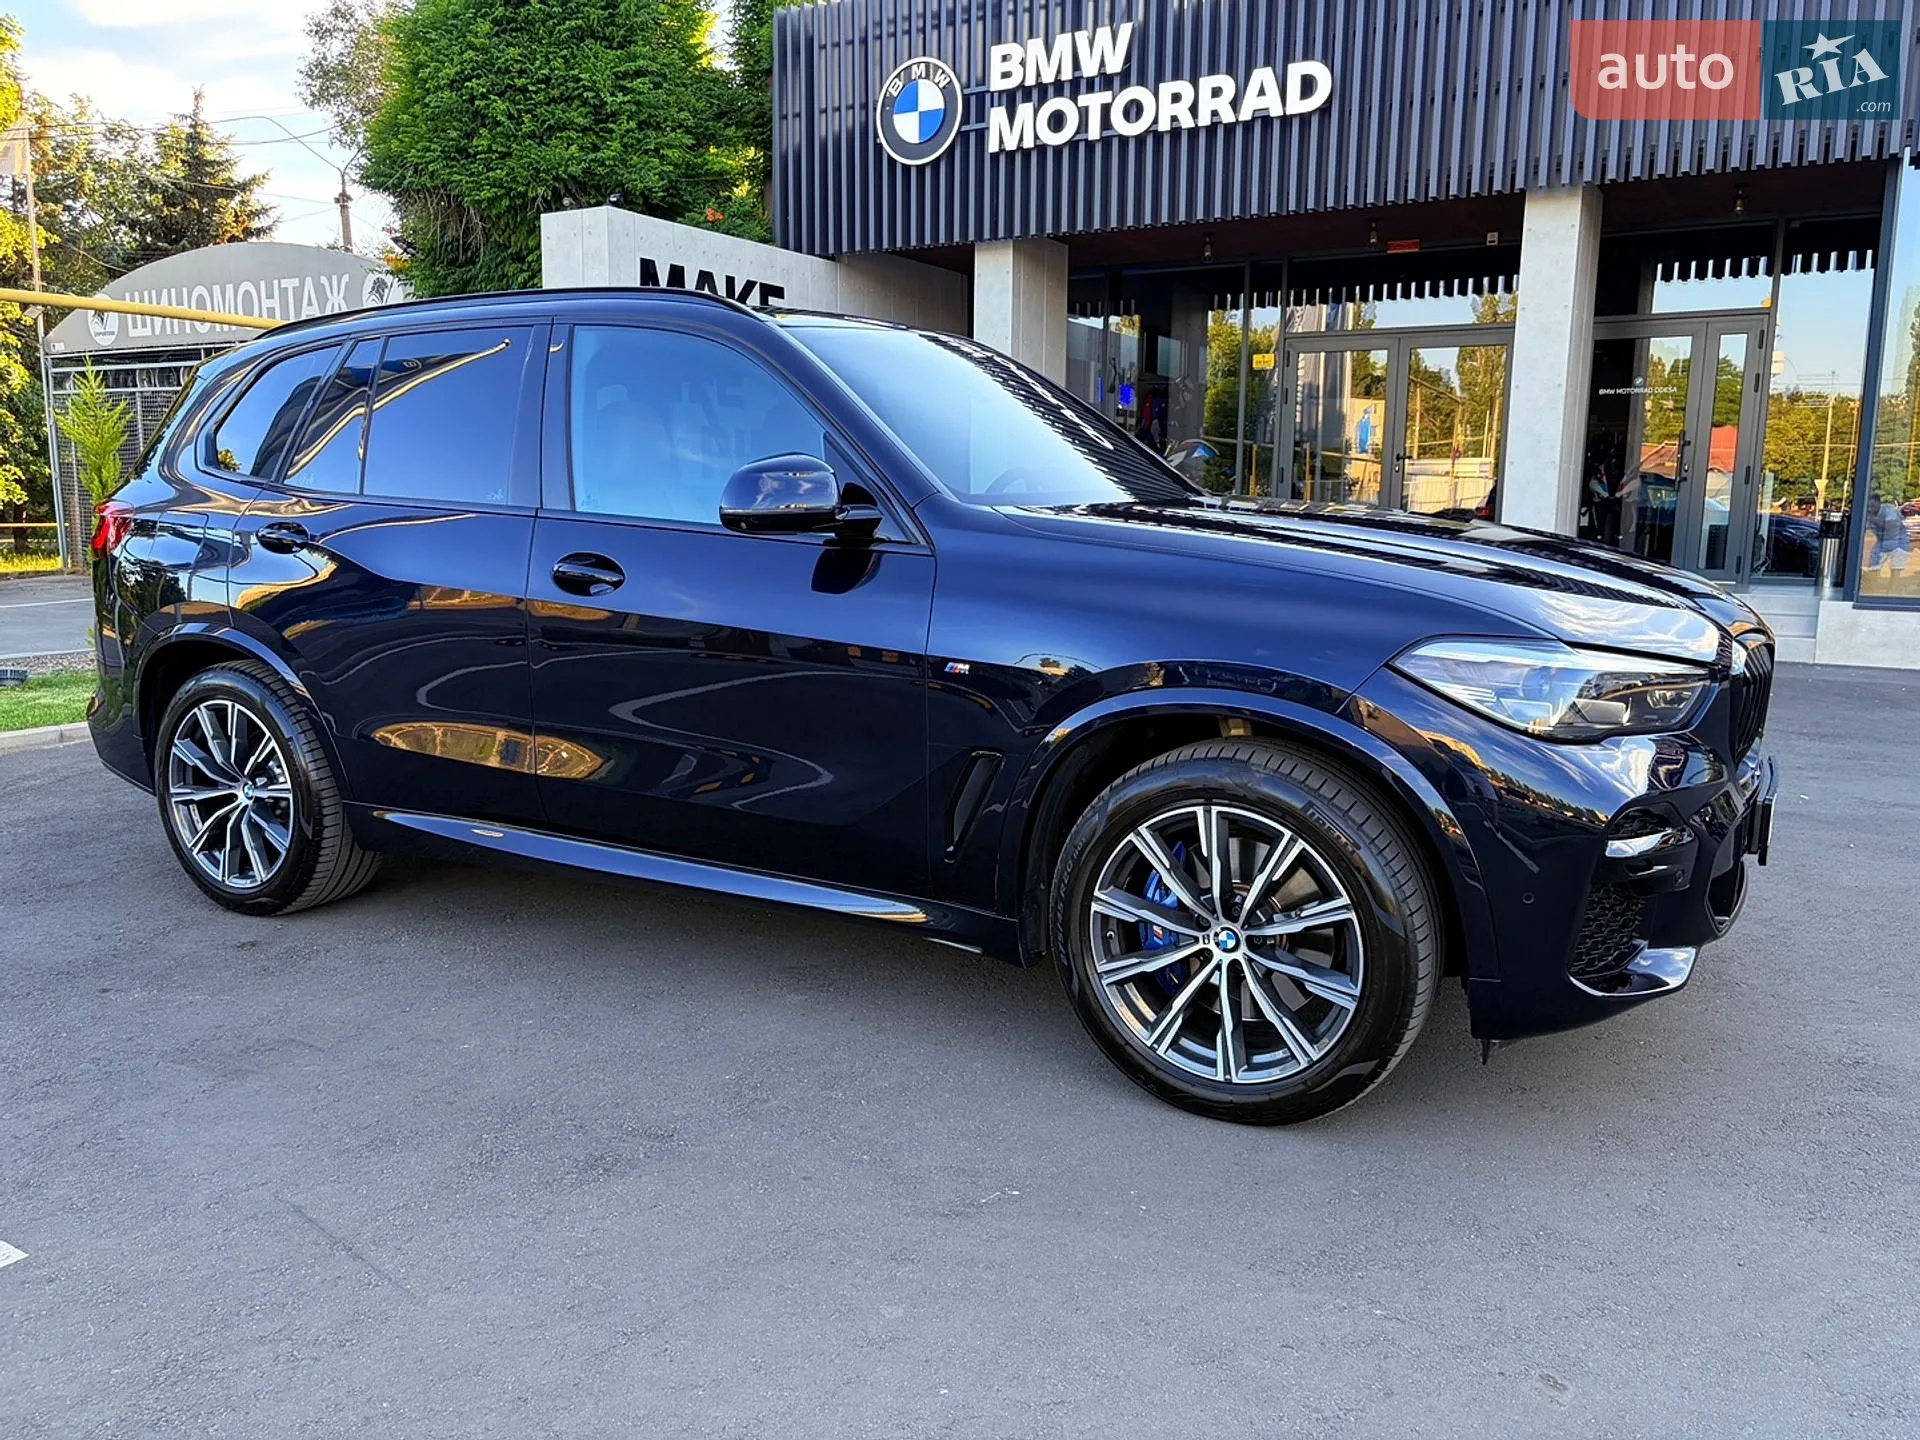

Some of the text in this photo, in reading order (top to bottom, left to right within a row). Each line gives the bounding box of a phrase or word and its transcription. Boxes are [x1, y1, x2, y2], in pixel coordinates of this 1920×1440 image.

[990, 22, 1134, 92] BMW
[988, 60, 1332, 153] MOTORRAD
[125, 273, 350, 337] ШИНОМОНТАЖ
[1599, 387, 1615, 396] BMW
[1616, 387, 1652, 395] MOTORRAD
